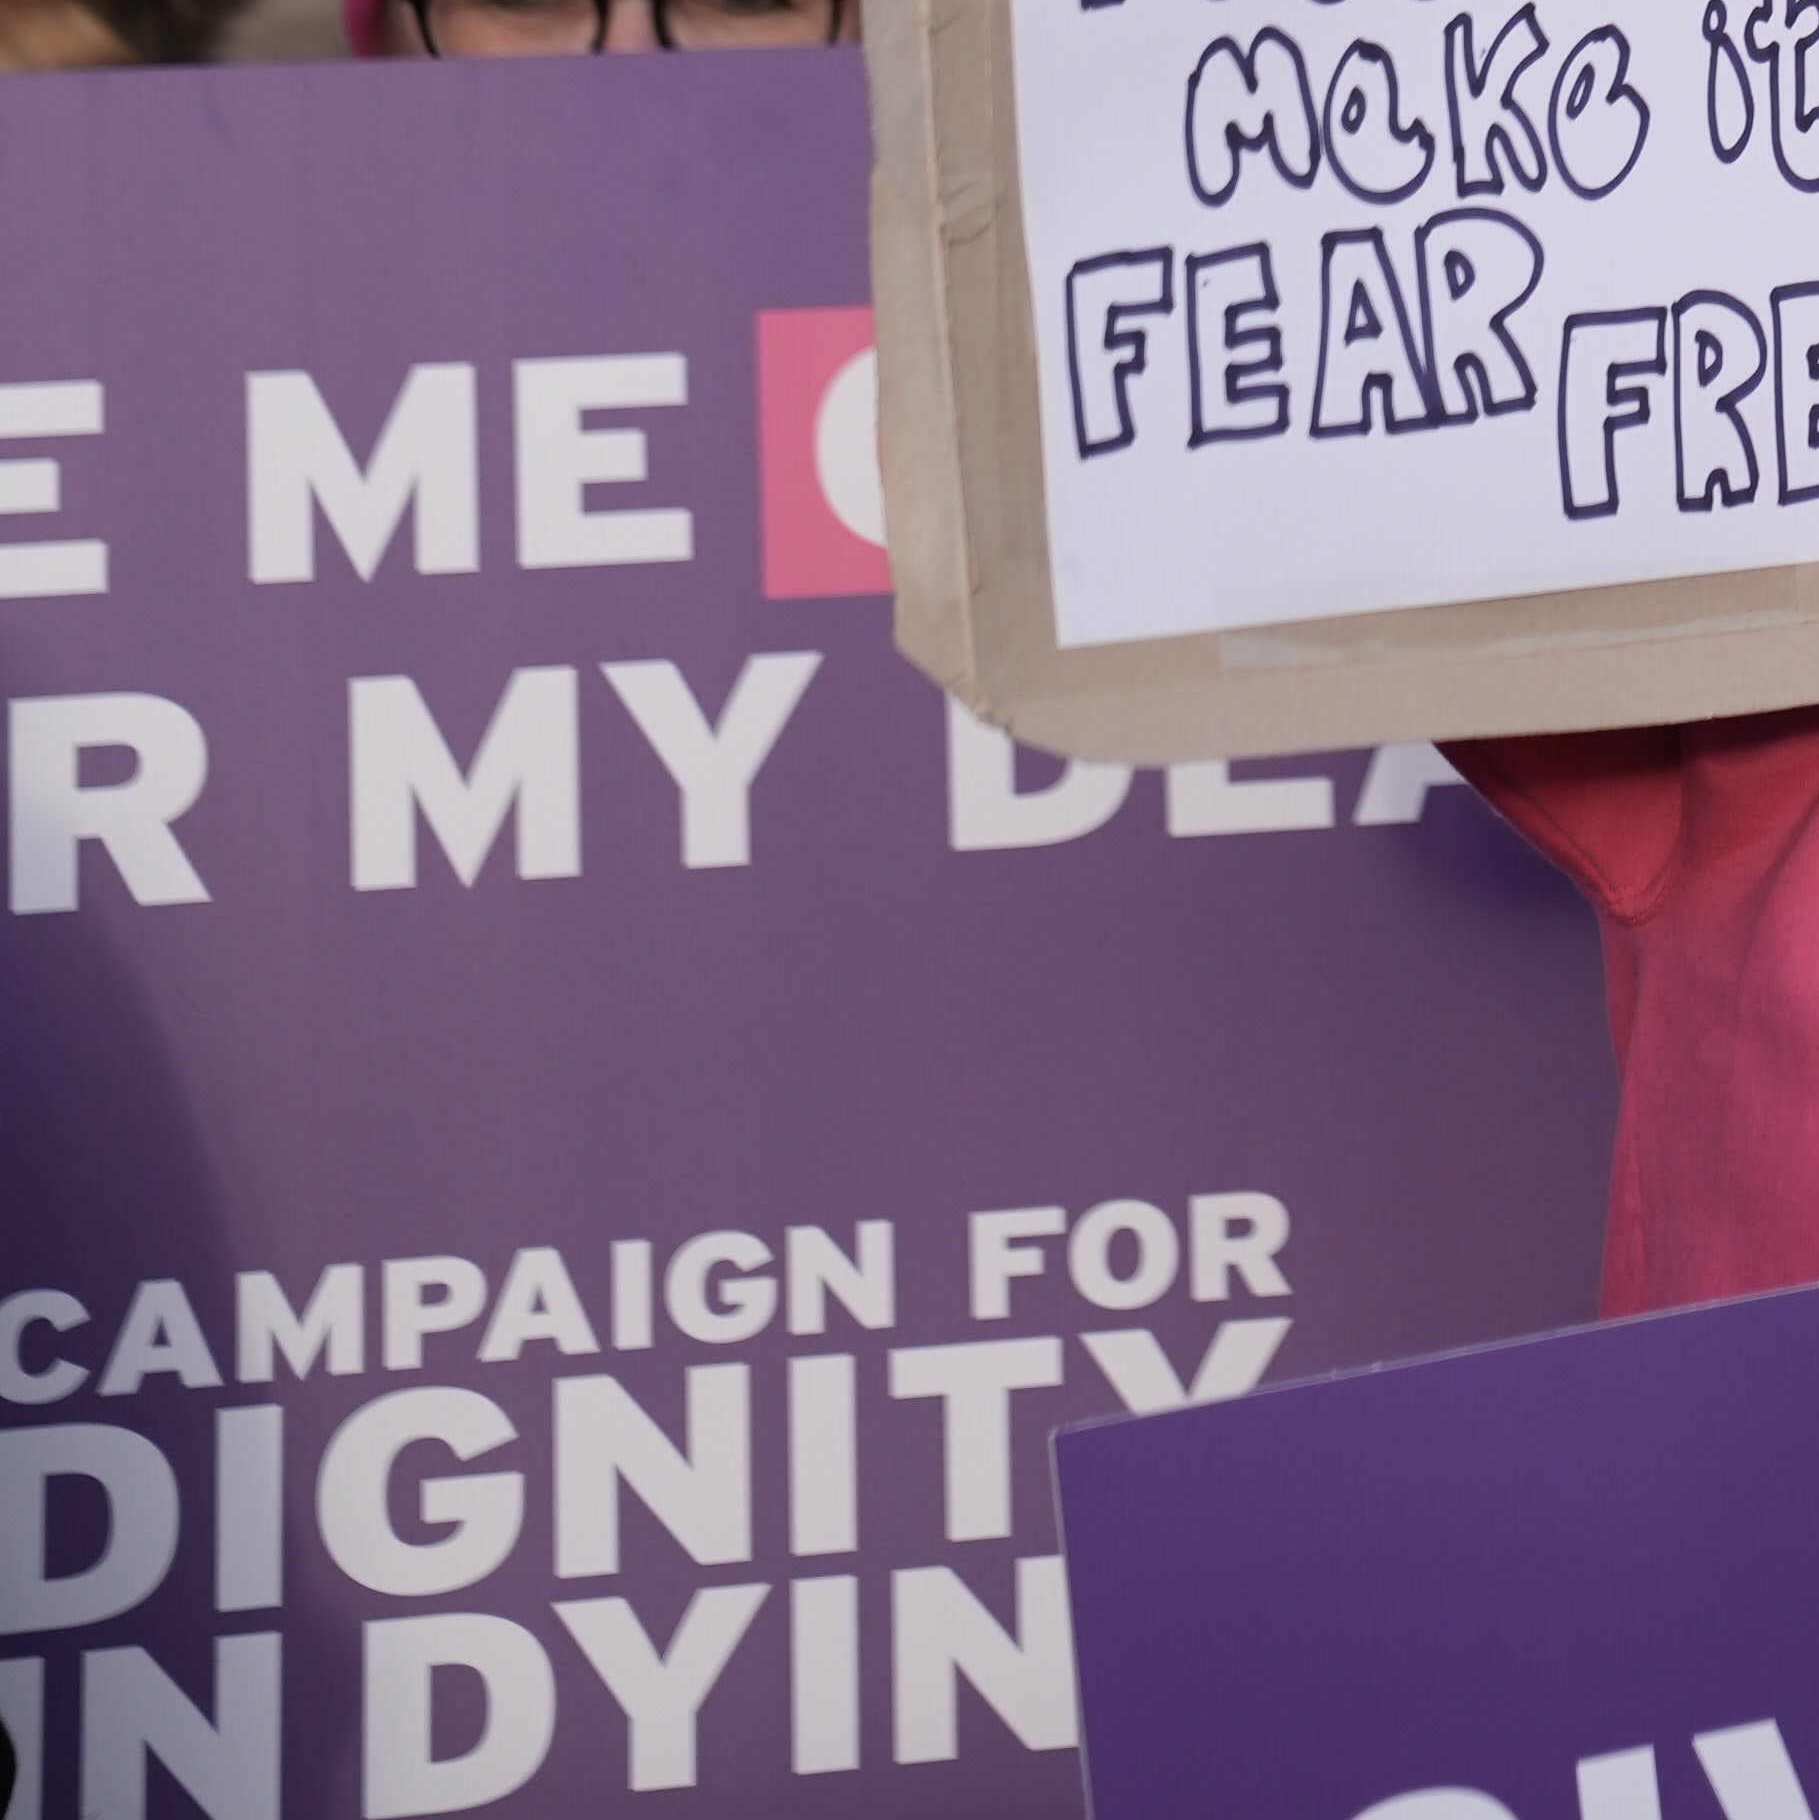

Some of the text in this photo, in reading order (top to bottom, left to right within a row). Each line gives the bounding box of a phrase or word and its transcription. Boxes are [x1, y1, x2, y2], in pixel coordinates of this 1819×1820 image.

[1066, 206, 1543, 459] FEAR
[245, 351, 694, 584] ME
[347, 650, 824, 893] MY
[0, 1190, 1293, 1405] CAMPAIGN FOR
